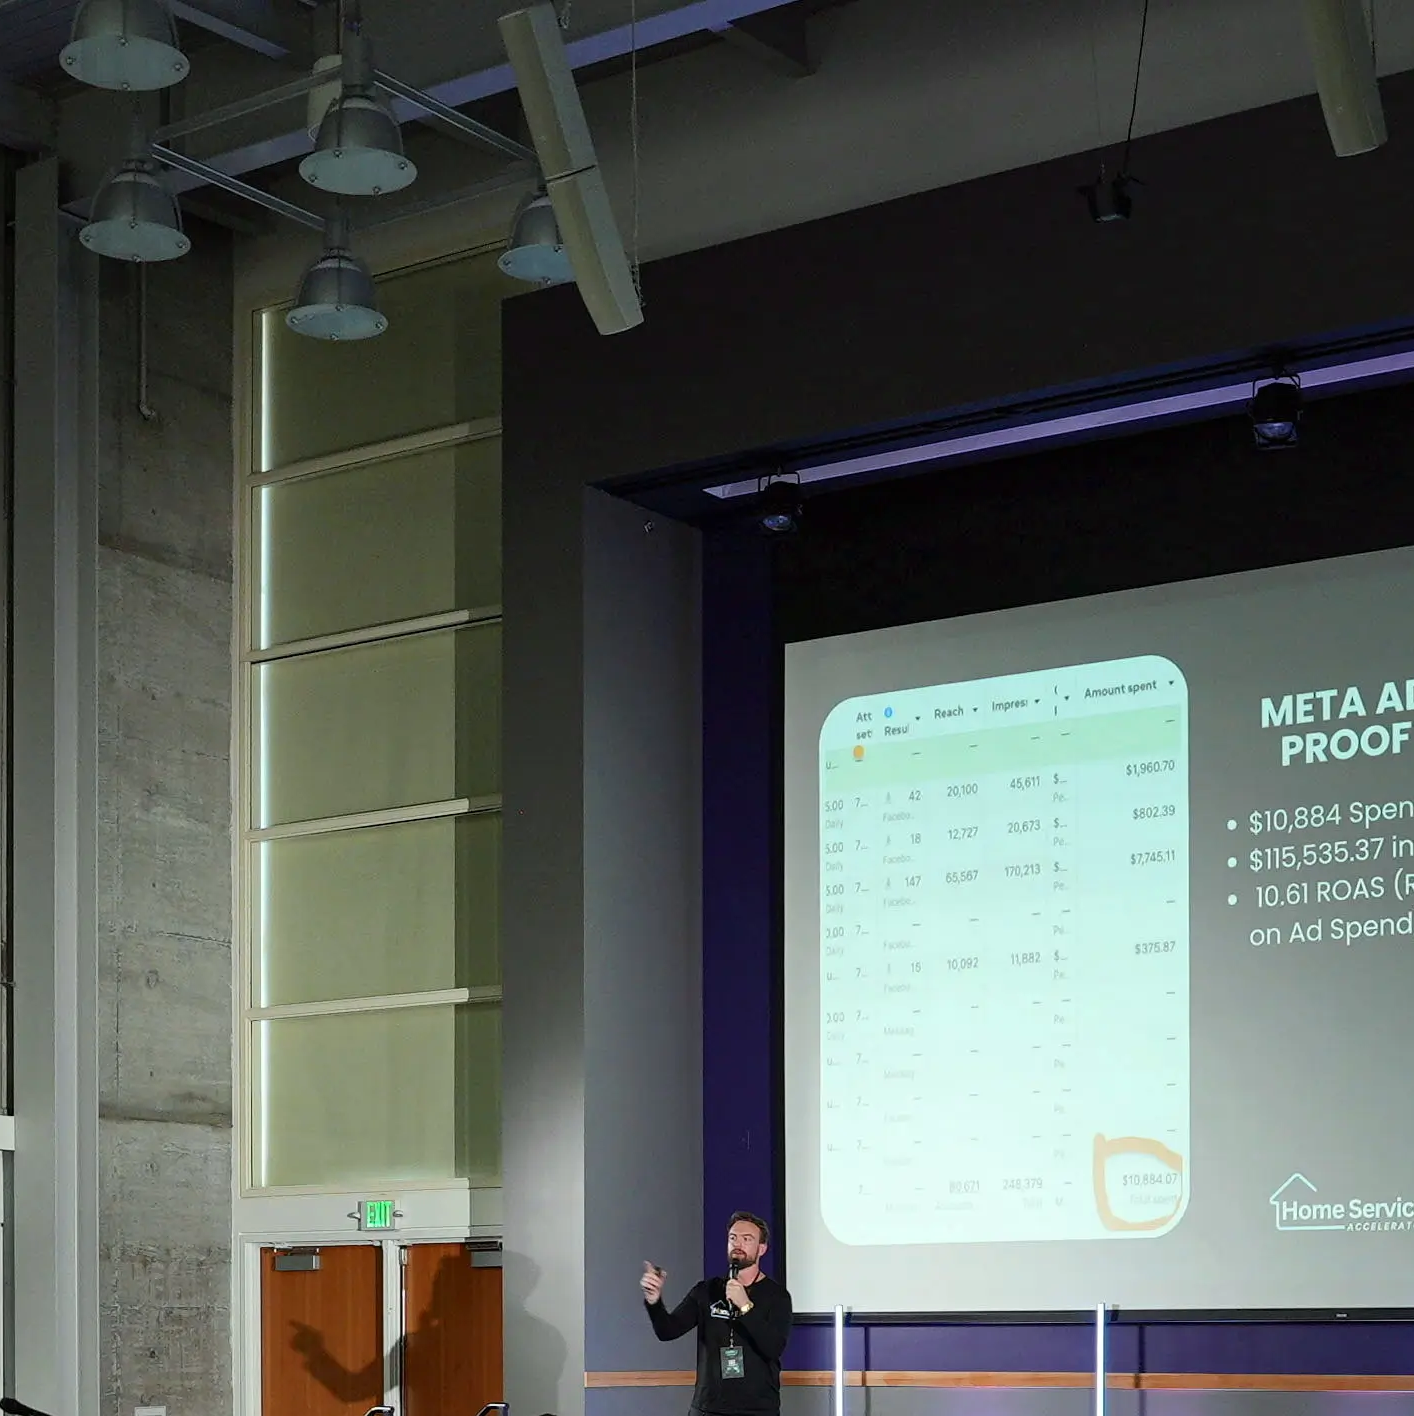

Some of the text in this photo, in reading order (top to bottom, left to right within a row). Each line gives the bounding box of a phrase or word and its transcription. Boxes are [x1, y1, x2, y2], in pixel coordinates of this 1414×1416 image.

[934, 706, 964, 719] Reach
[1084, 686, 1125, 699] Amount
[1127, 681, 1157, 695] spent
[1261, 687, 1366, 728] META
[1282, 721, 1412, 766] PROOF
[909, 760, 1175, 801] 42 20,100 45,611 $1,960.70
[949, 827, 978, 840] 12,727
[1008, 820, 1041, 834] 20,673
[1133, 805, 1176, 820] $802.39
[1249, 803, 1342, 835] $10,884
[946, 870, 978, 885] 65,567
[1005, 863, 1041, 878] 170,213
[1131, 850, 1175, 865] $7,745.11
[1249, 837, 1384, 871] $115,535.37
[1391, 835, 1414, 858] in
[1256, 882, 1309, 907] 10.61
[1317, 877, 1385, 903] ROAS
[1249, 926, 1281, 946] on
[1289, 919, 1323, 943] Ad
[947, 957, 978, 971] 10,092
[1010, 952, 1041, 966] 11,882
[1135, 941, 1176, 955] $375.87
[1122, 1172, 1179, 1187] $10,884.07
[367, 1201, 392, 1228] EXIT
[1282, 1200, 1345, 1221] Home
